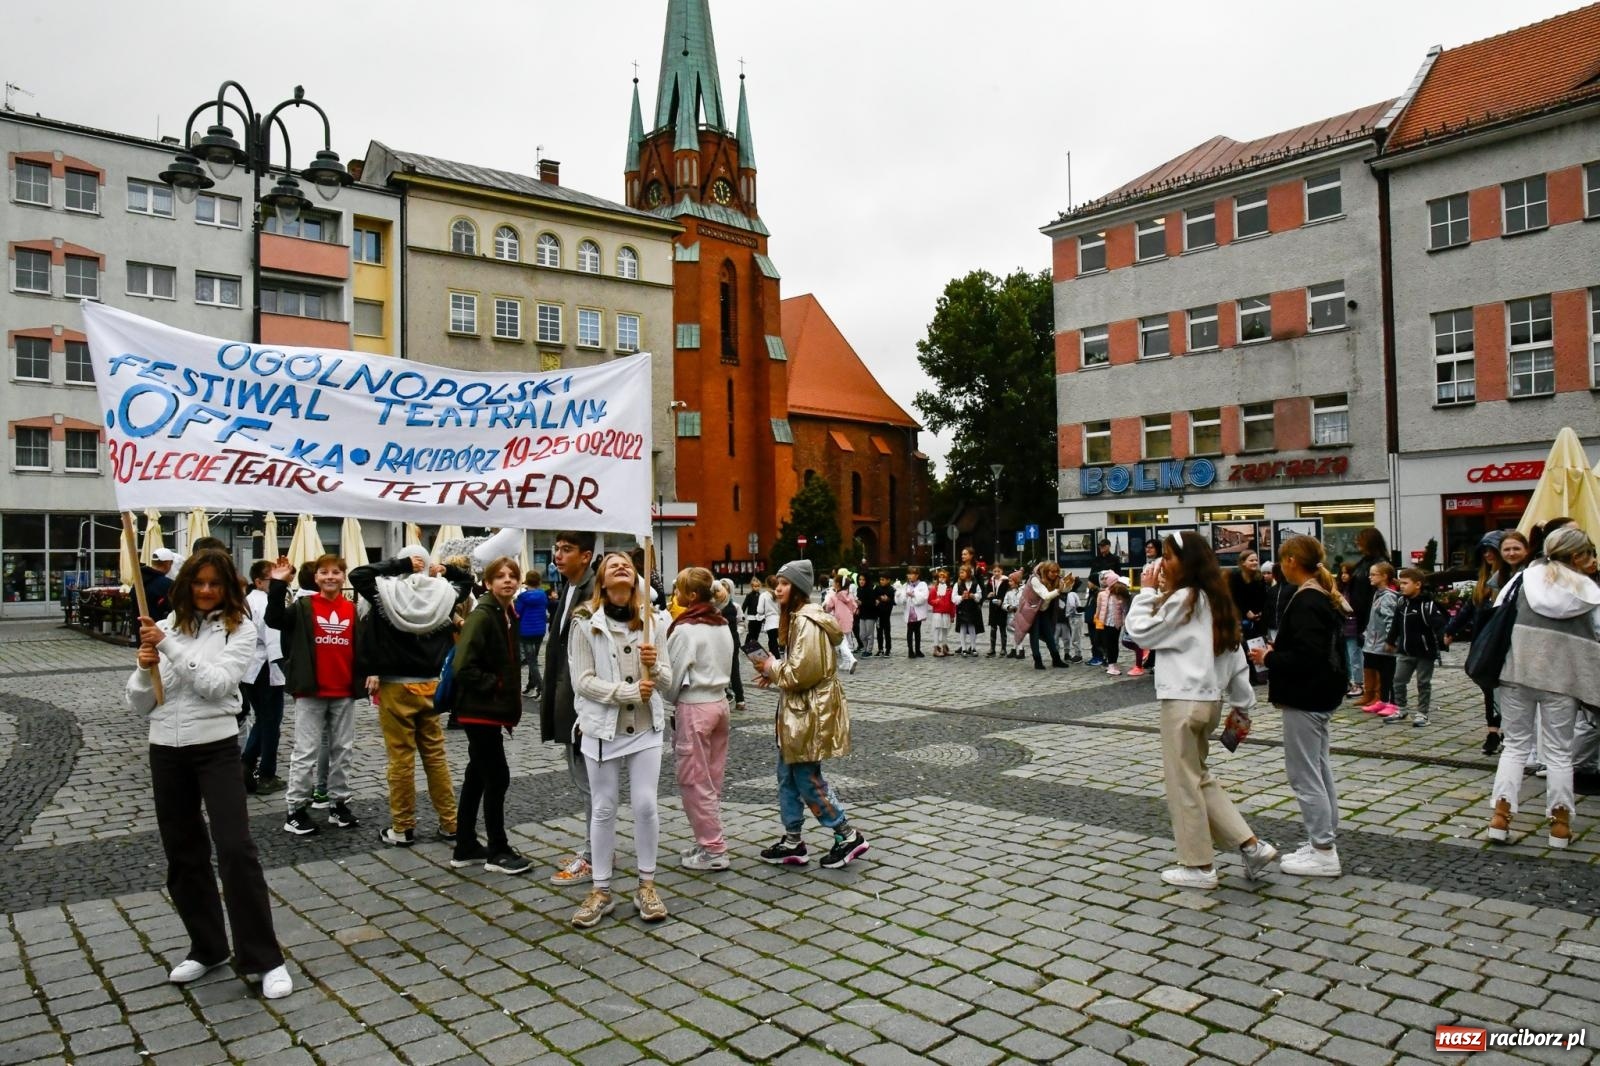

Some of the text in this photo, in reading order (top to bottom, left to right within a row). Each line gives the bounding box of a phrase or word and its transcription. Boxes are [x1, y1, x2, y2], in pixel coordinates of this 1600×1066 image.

[108, 353, 607, 430] FESTIWAL TEATRALNY
[108, 438, 604, 515] 30-LECIE TEATRU TETRAEDR
[374, 441, 500, 475] RACIBÓRZ
[1079, 455, 1349, 496] BOLKO zaprasza
[315, 634, 349, 646] adidas
